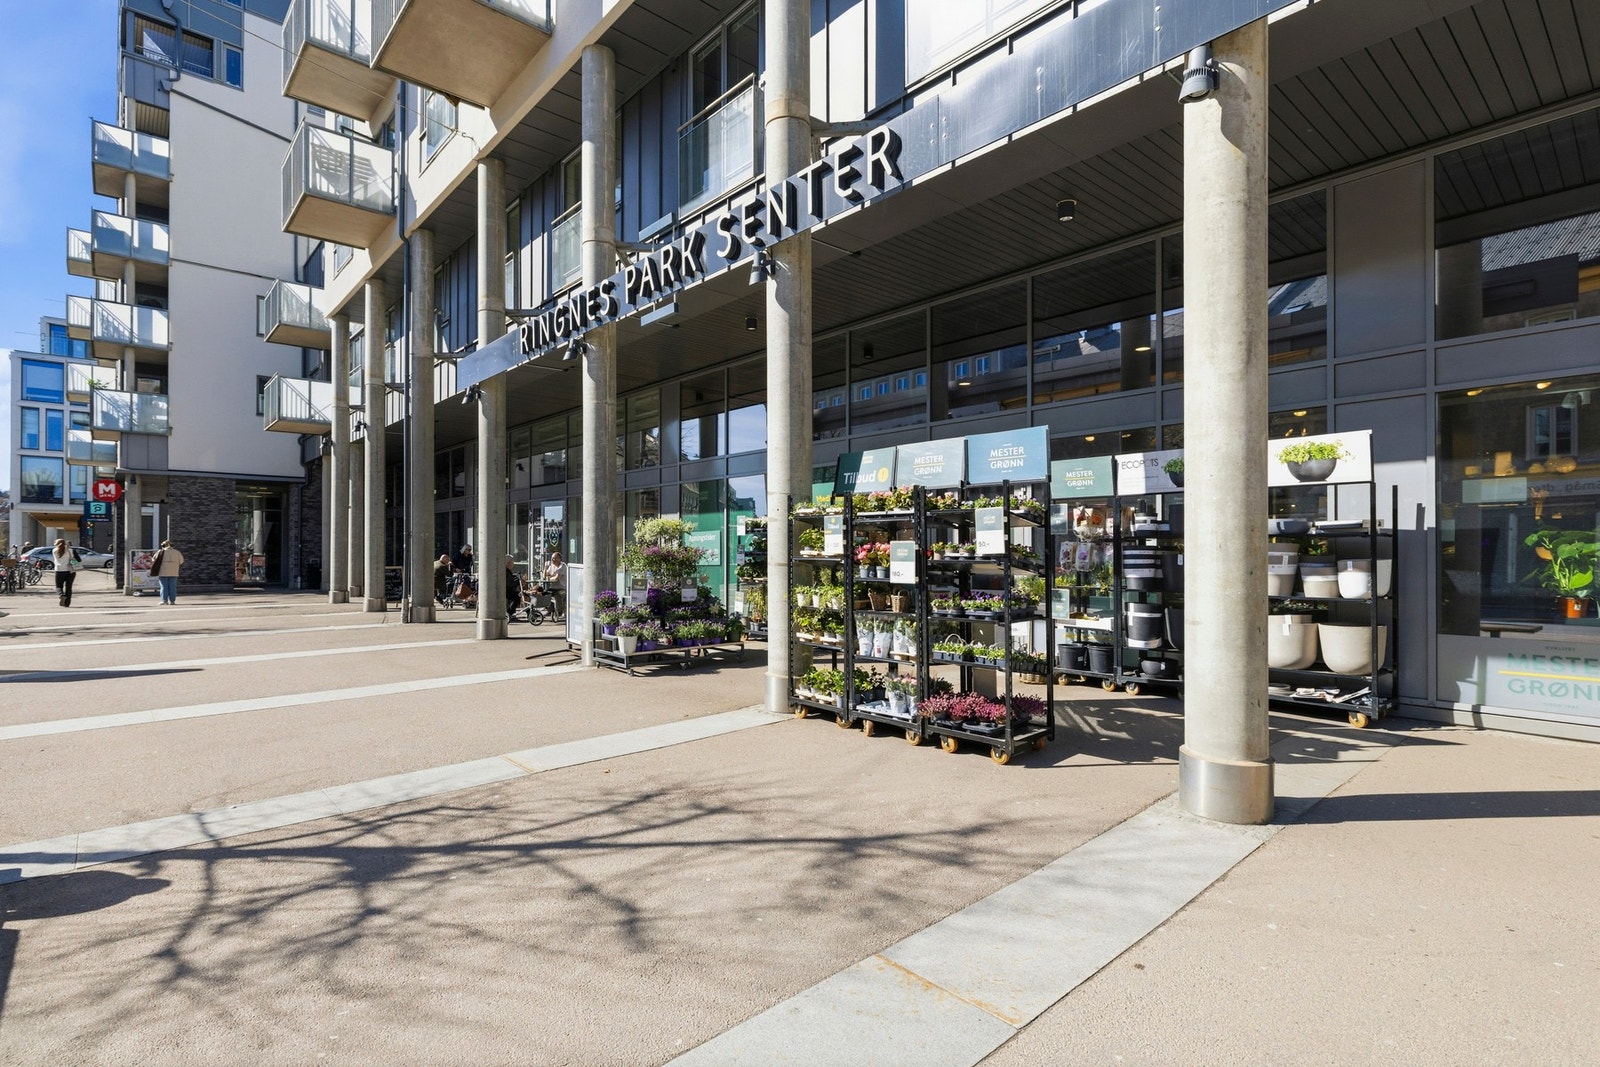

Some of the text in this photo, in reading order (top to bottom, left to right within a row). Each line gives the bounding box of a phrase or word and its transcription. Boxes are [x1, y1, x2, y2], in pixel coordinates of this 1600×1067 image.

[519, 126, 902, 355] RINGNES PARK SENTER
[990, 446, 1025, 457] MESTER
[914, 455, 944, 465] MESTER
[990, 459, 1024, 469] GRØNN
[1121, 459, 1159, 470] ECOPTS
[914, 466, 942, 476] GRØNN
[1066, 470, 1094, 478] MESTER
[844, 470, 877, 485] Tilbud
[1066, 480, 1094, 488] GRØNN
[1507, 652, 1599, 675] MESTE
[1507, 678, 1600, 702] GRØN
